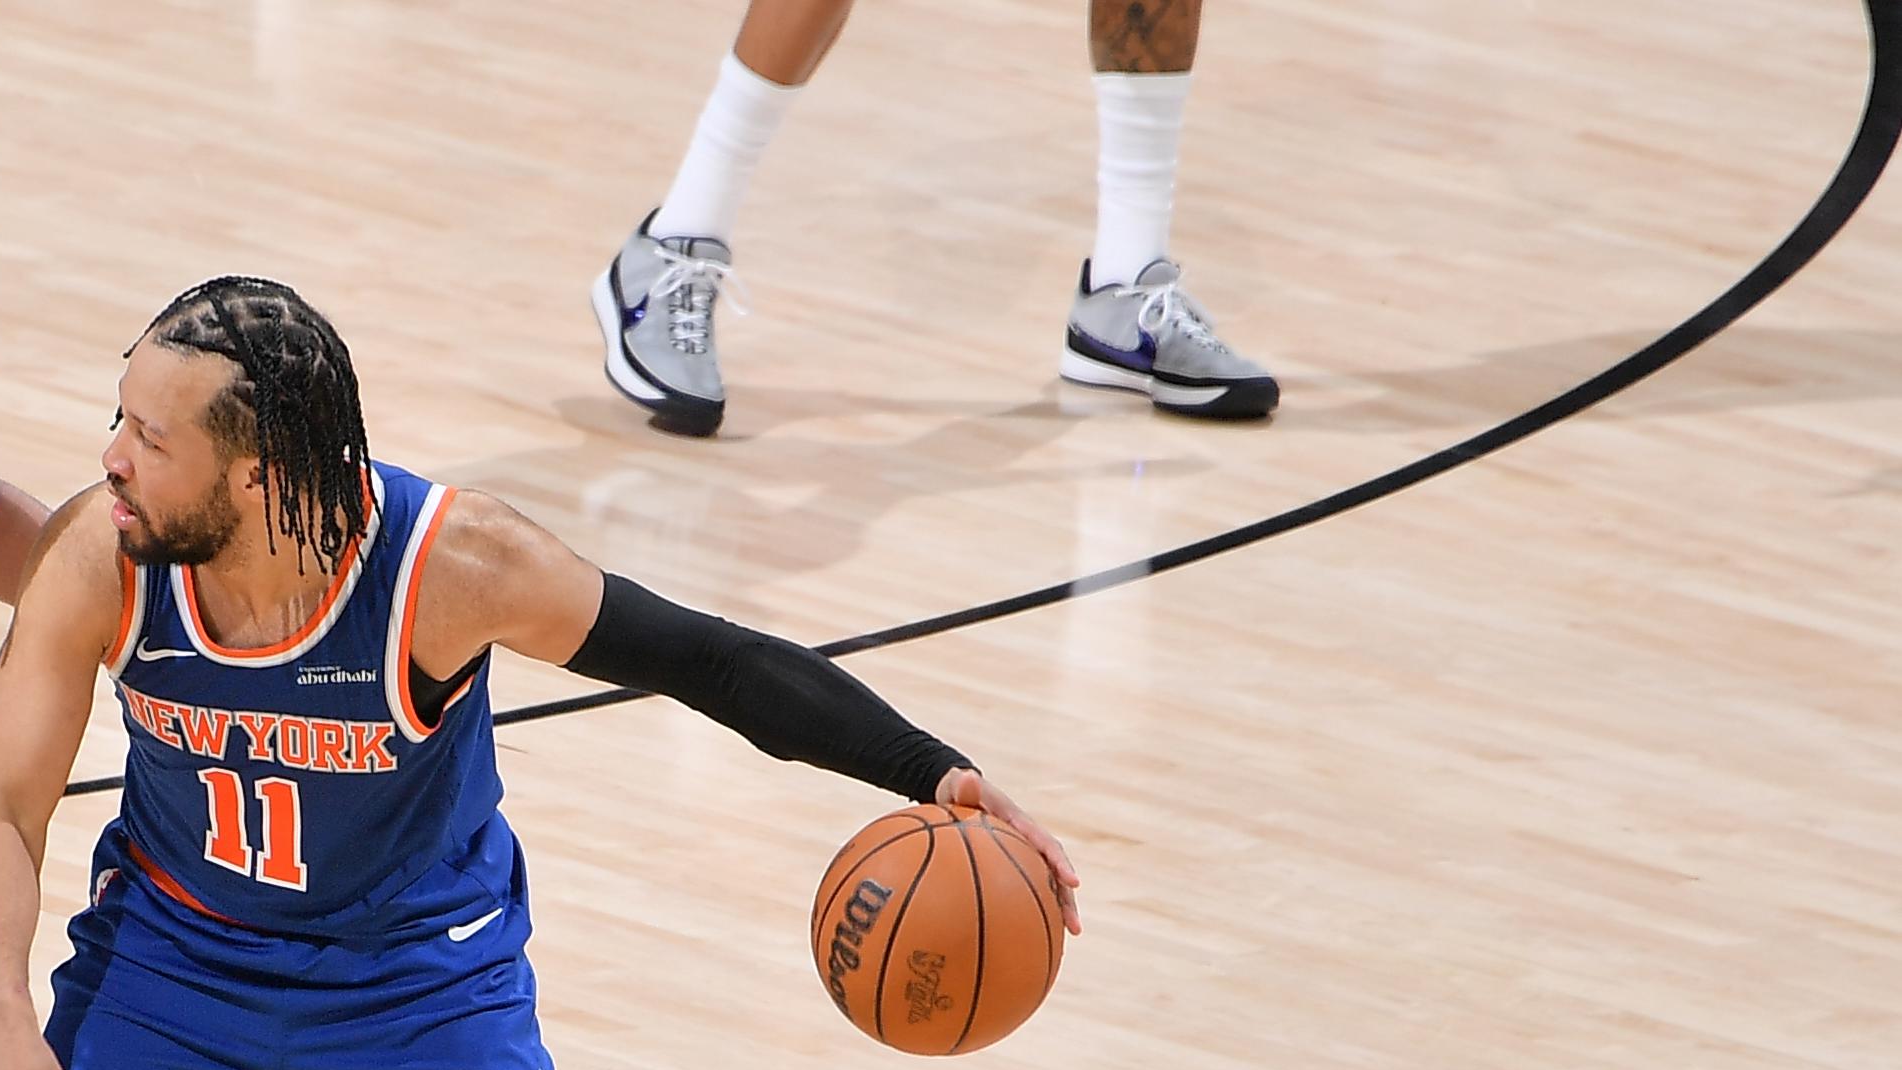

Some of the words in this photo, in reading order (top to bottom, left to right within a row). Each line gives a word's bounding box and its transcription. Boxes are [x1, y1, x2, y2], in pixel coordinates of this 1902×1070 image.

[297, 671, 328, 685] abu
[330, 669, 377, 683] dhabi
[122, 684, 233, 760] NEW
[236, 713, 398, 774] YORK
[198, 766, 308, 893] 11
